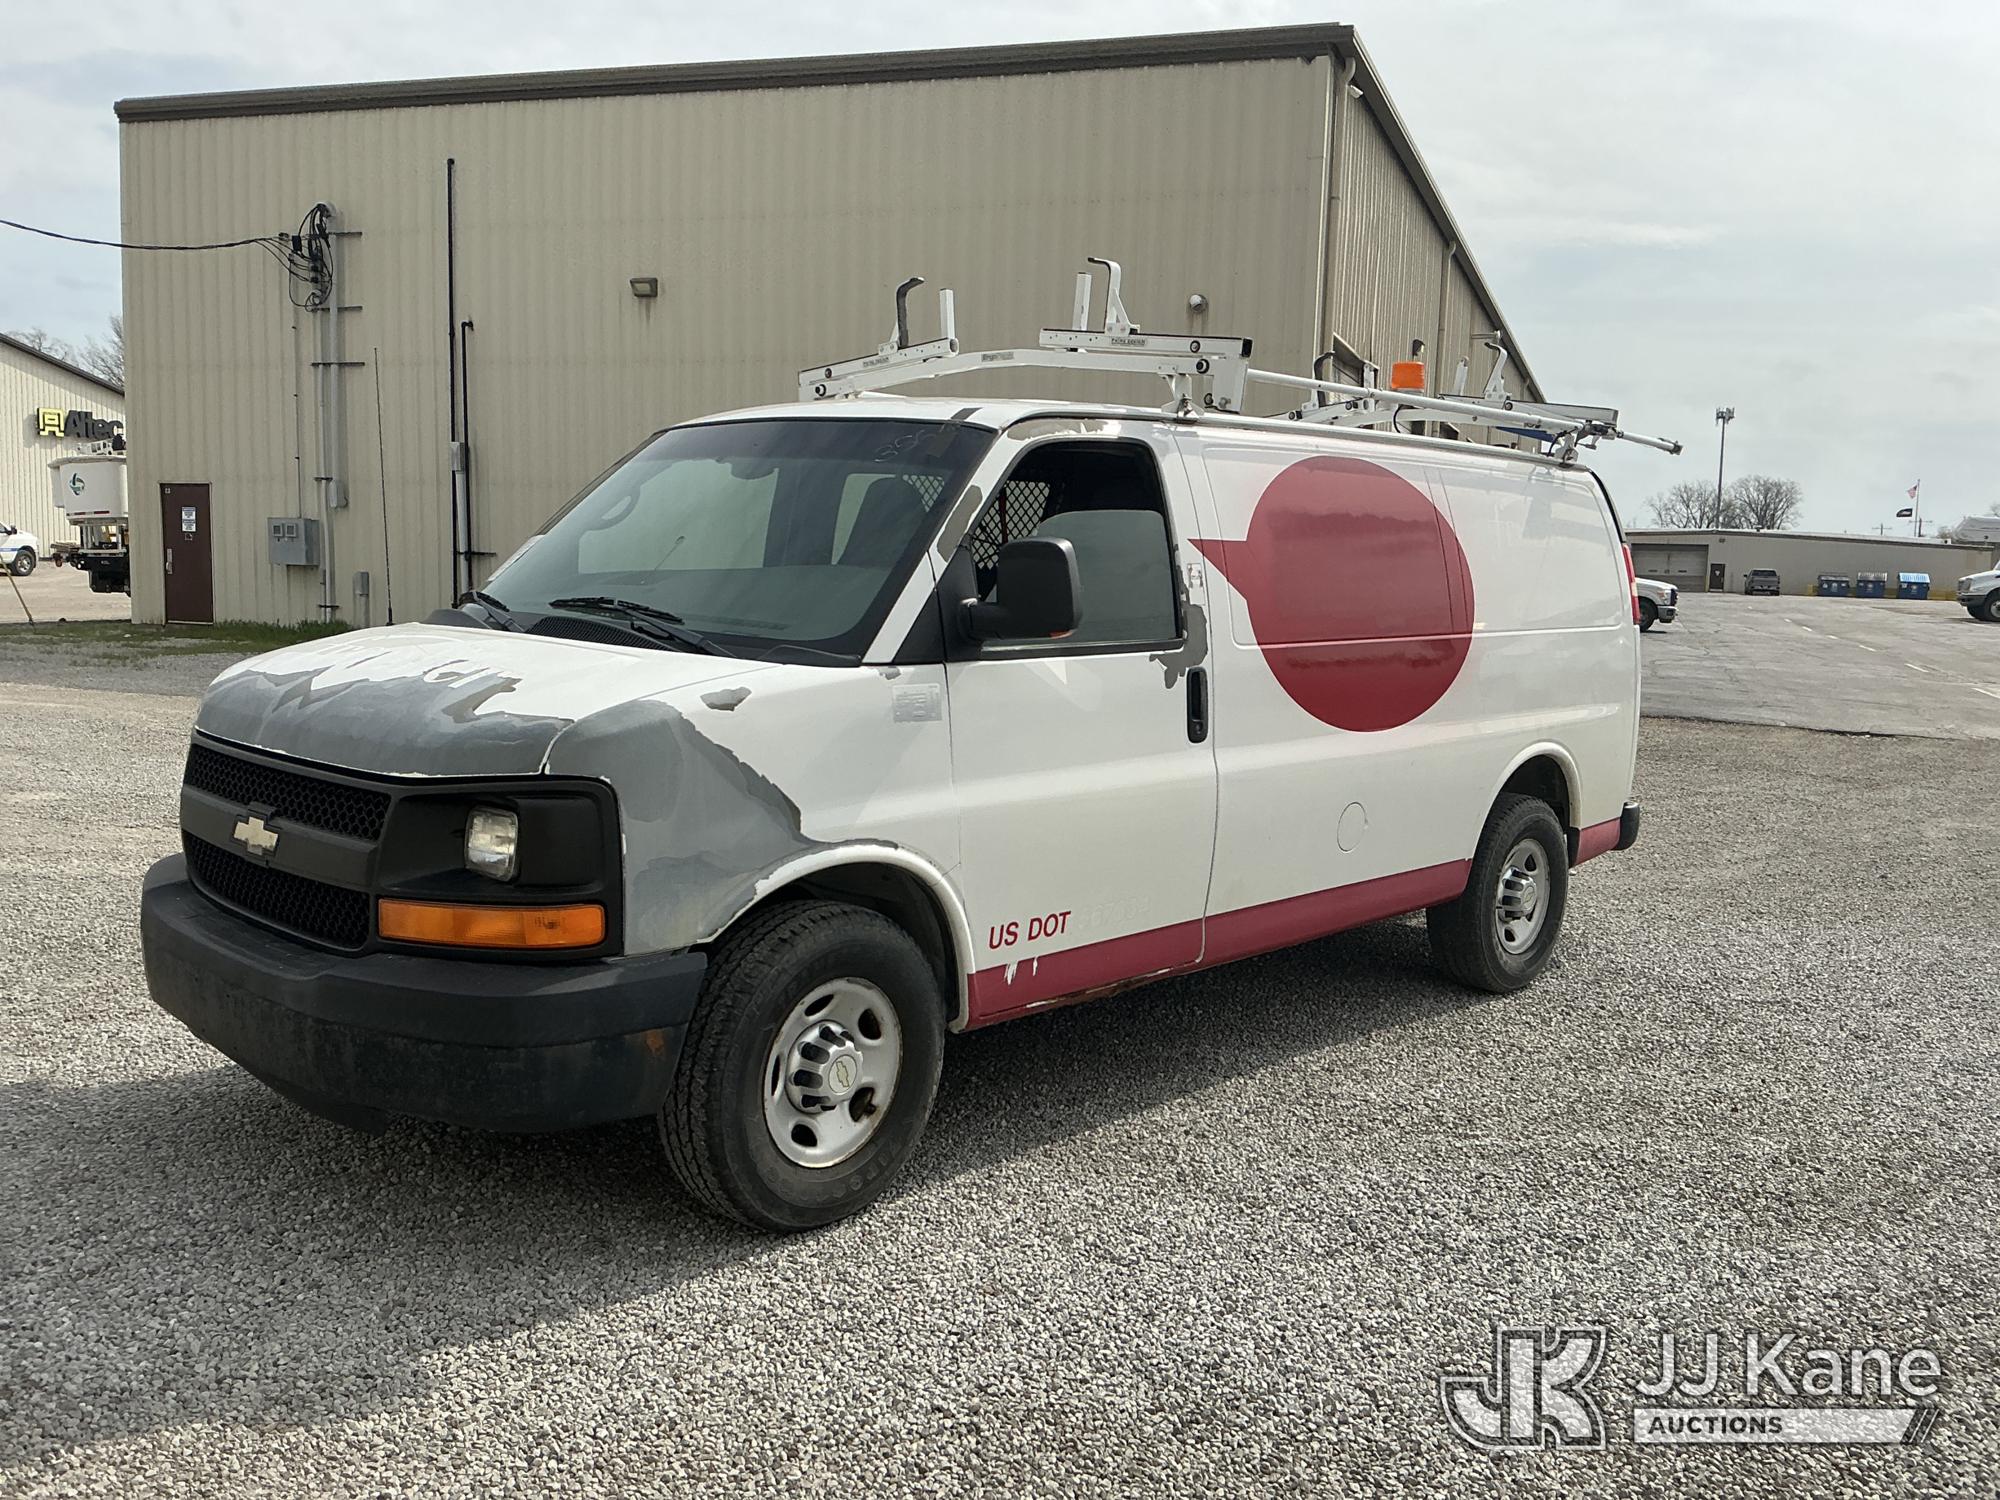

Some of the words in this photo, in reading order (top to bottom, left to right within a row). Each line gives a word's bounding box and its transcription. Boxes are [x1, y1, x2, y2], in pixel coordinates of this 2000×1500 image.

[65, 409, 124, 440] Altec
[989, 921, 1019, 949] US
[1028, 910, 1071, 941] DOT
